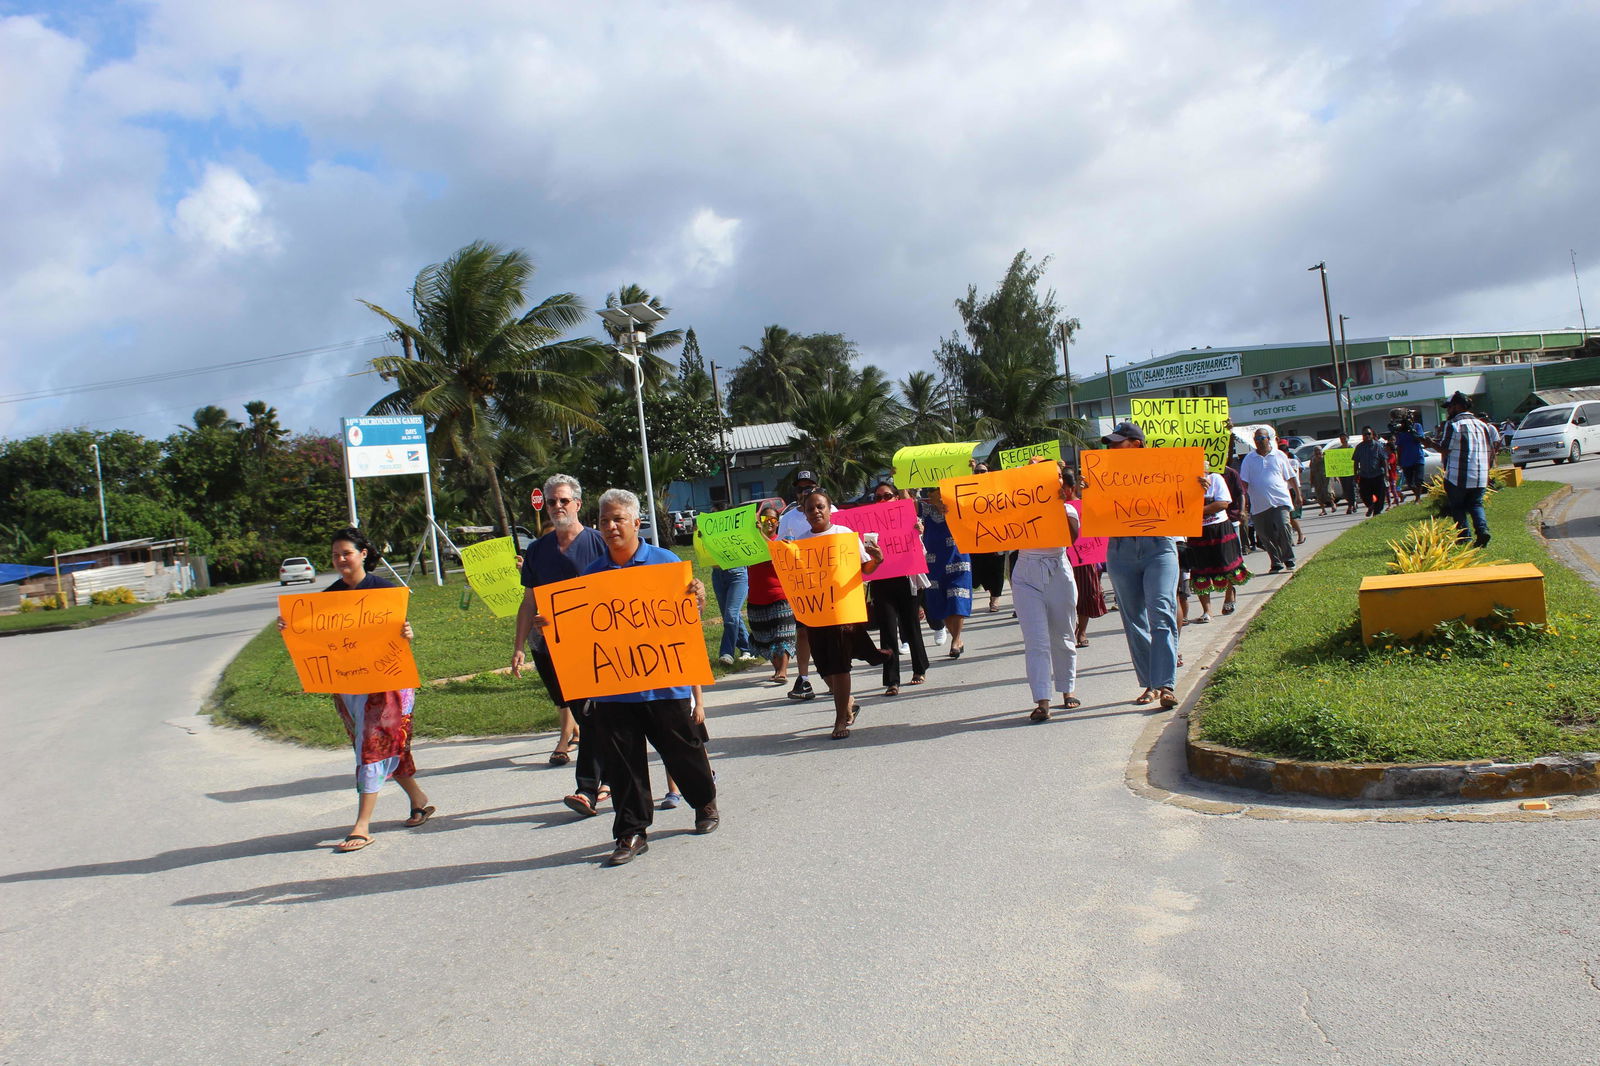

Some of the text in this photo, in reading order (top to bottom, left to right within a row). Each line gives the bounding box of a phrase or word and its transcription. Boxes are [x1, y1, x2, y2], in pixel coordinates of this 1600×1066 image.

[1143, 369, 1165, 380] ISLAND
[1165, 365, 1184, 376] PRIDE
[1184, 357, 1232, 373] SUPERMARKET
[1375, 392, 1385, 400] OF
[1386, 390, 1408, 399] GUAM
[1132, 399, 1228, 417] DON'T LET THE
[1253, 404, 1296, 416] POST OFFICE
[1133, 418, 1180, 435] MAYOR
[1186, 419, 1211, 434] USE
[909, 459, 954, 484] AUDIT
[1085, 453, 1185, 491] Receivership
[531, 495, 544, 504] STOP
[955, 482, 1052, 520] FORENSIC
[705, 510, 747, 536] CABINET
[975, 516, 1043, 547] AUDIT
[712, 534, 748, 549] PLEASE
[788, 571, 827, 591] SHIP
[790, 585, 835, 615] NOW!
[290, 594, 393, 635] Claims Trust
[551, 586, 698, 643] FORENSIC
[328, 637, 358, 652] is for
[303, 655, 333, 684] 177
[593, 642, 685, 683] AUDIT
